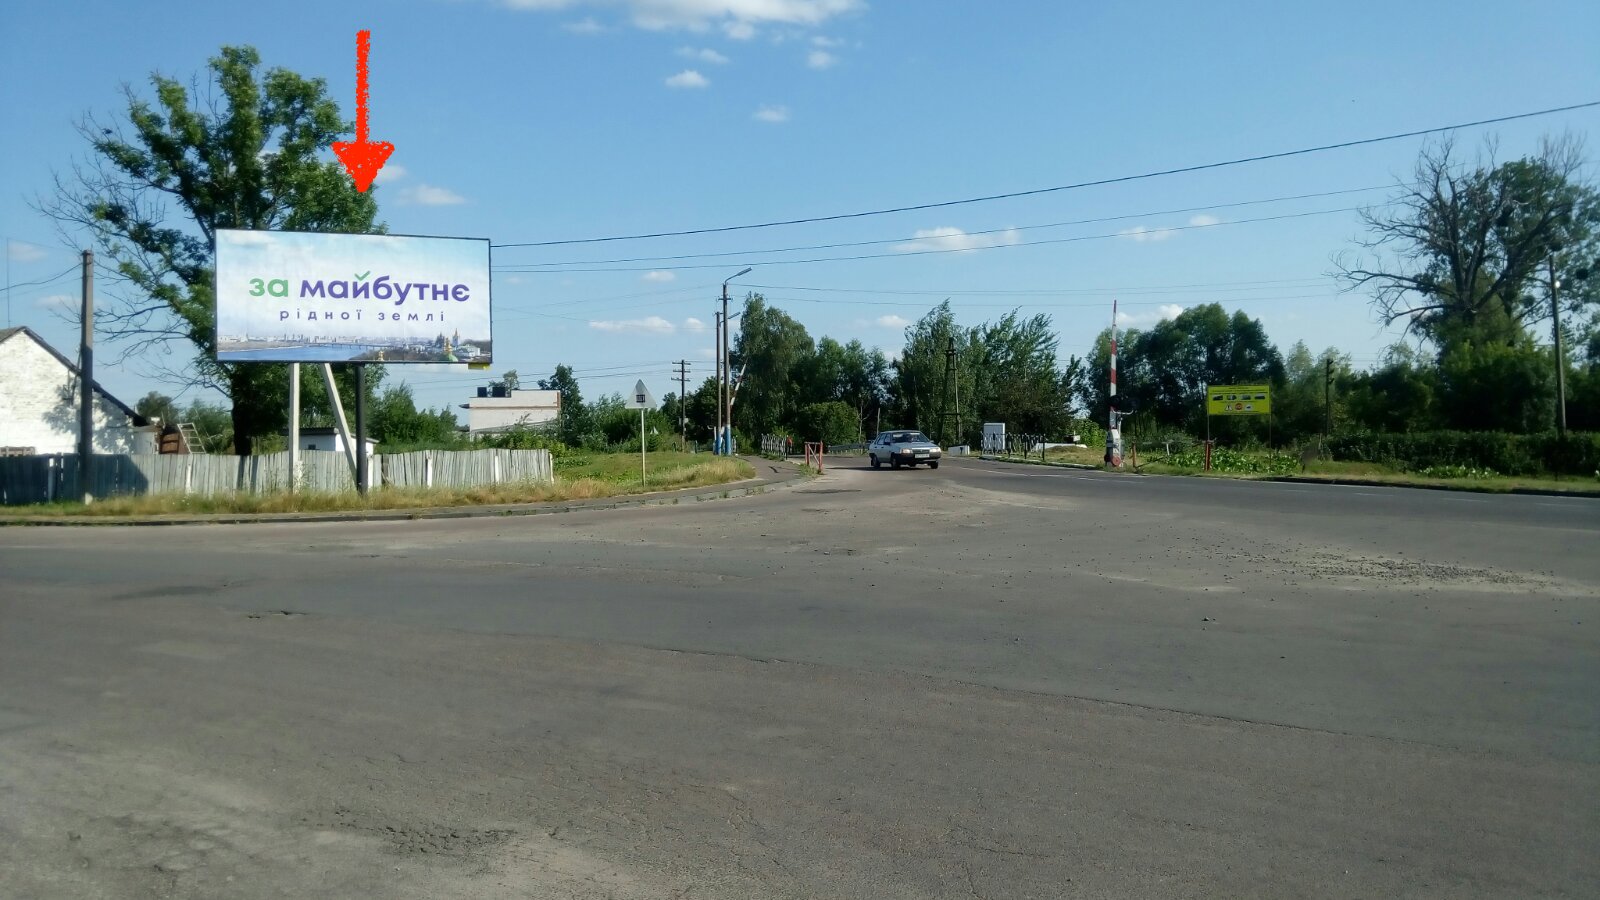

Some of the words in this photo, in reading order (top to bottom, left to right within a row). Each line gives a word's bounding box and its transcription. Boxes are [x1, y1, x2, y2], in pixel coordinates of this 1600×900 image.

[249, 278, 289, 297] за
[300, 271, 470, 305] майбутнє
[279, 309, 362, 321] рідної
[378, 311, 444, 321] землі
